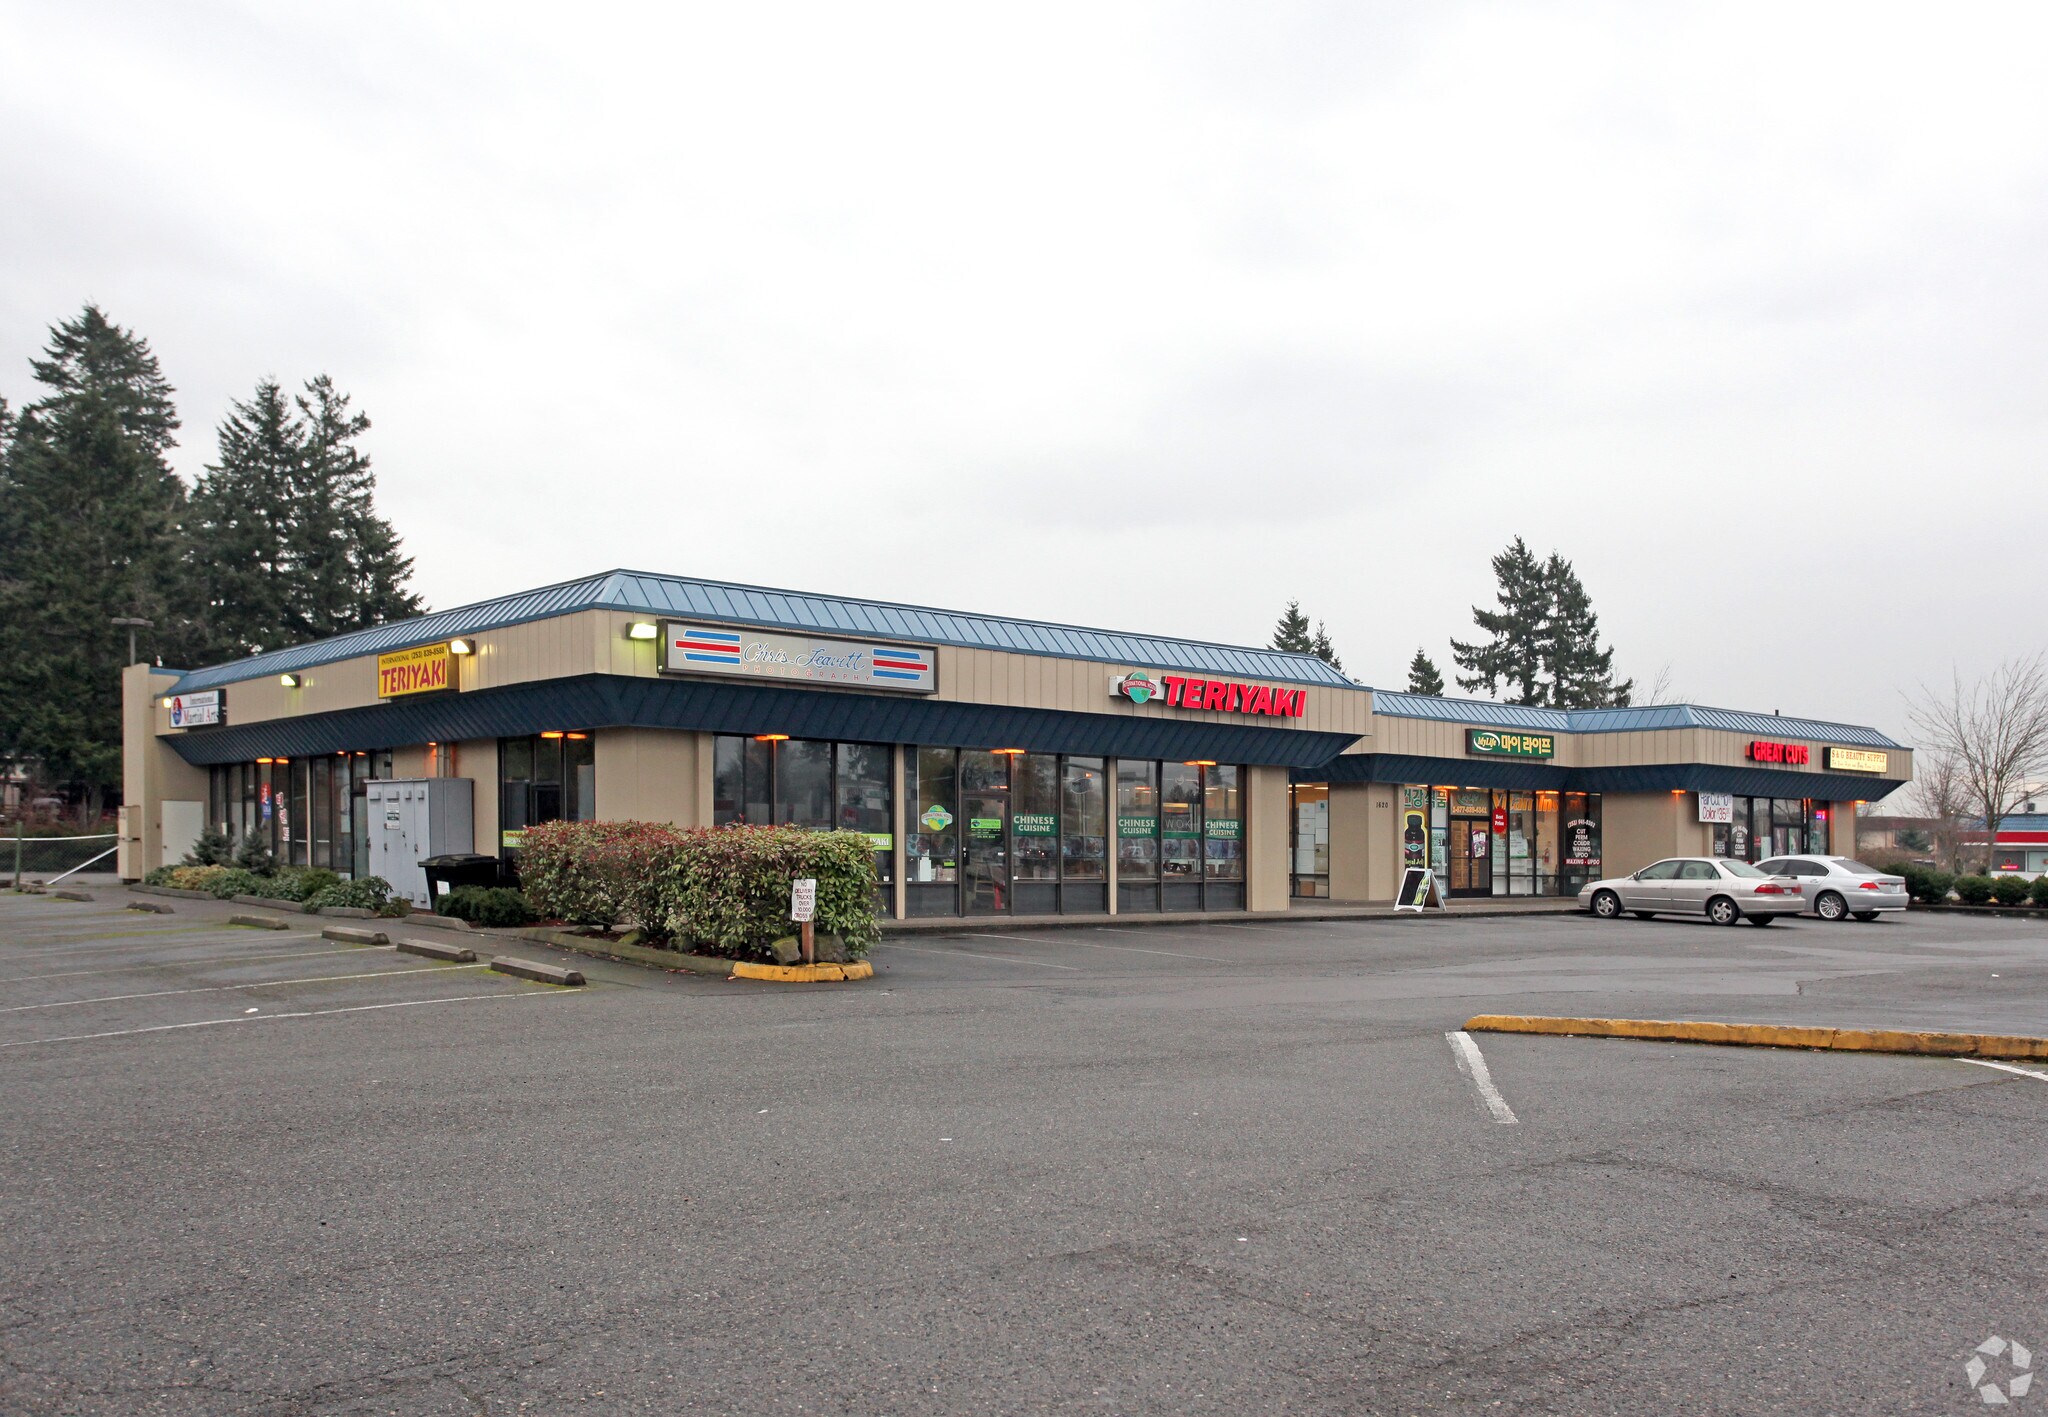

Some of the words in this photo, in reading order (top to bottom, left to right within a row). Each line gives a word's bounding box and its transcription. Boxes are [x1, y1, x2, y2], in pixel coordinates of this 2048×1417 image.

[743, 641, 788, 664] Chris
[795, 648, 872, 671] Leavitt
[381, 658, 446, 694] TERIYAKI
[743, 665, 870, 681] PHOTOGRAPHY
[1165, 675, 1307, 718] TERIYAKI
[183, 707, 204, 724] Martial
[1501, 735, 1521, 753] 마이
[1522, 737, 1551, 754] 라이프
[1754, 741, 1784, 763] GREAT
[1785, 744, 1809, 765] CUTS
[1845, 751, 1866, 761] BEAUTY
[1867, 754, 1886, 763] SUPPLY
[1013, 816, 1055, 825] CHINESE
[1118, 819, 1156, 828] CHINESE
[1205, 821, 1239, 830] CHINESE
[1018, 824, 1051, 832] CUISINE
[1122, 827, 1152, 835] CUISINE
[870, 837, 889, 846] YAKI
